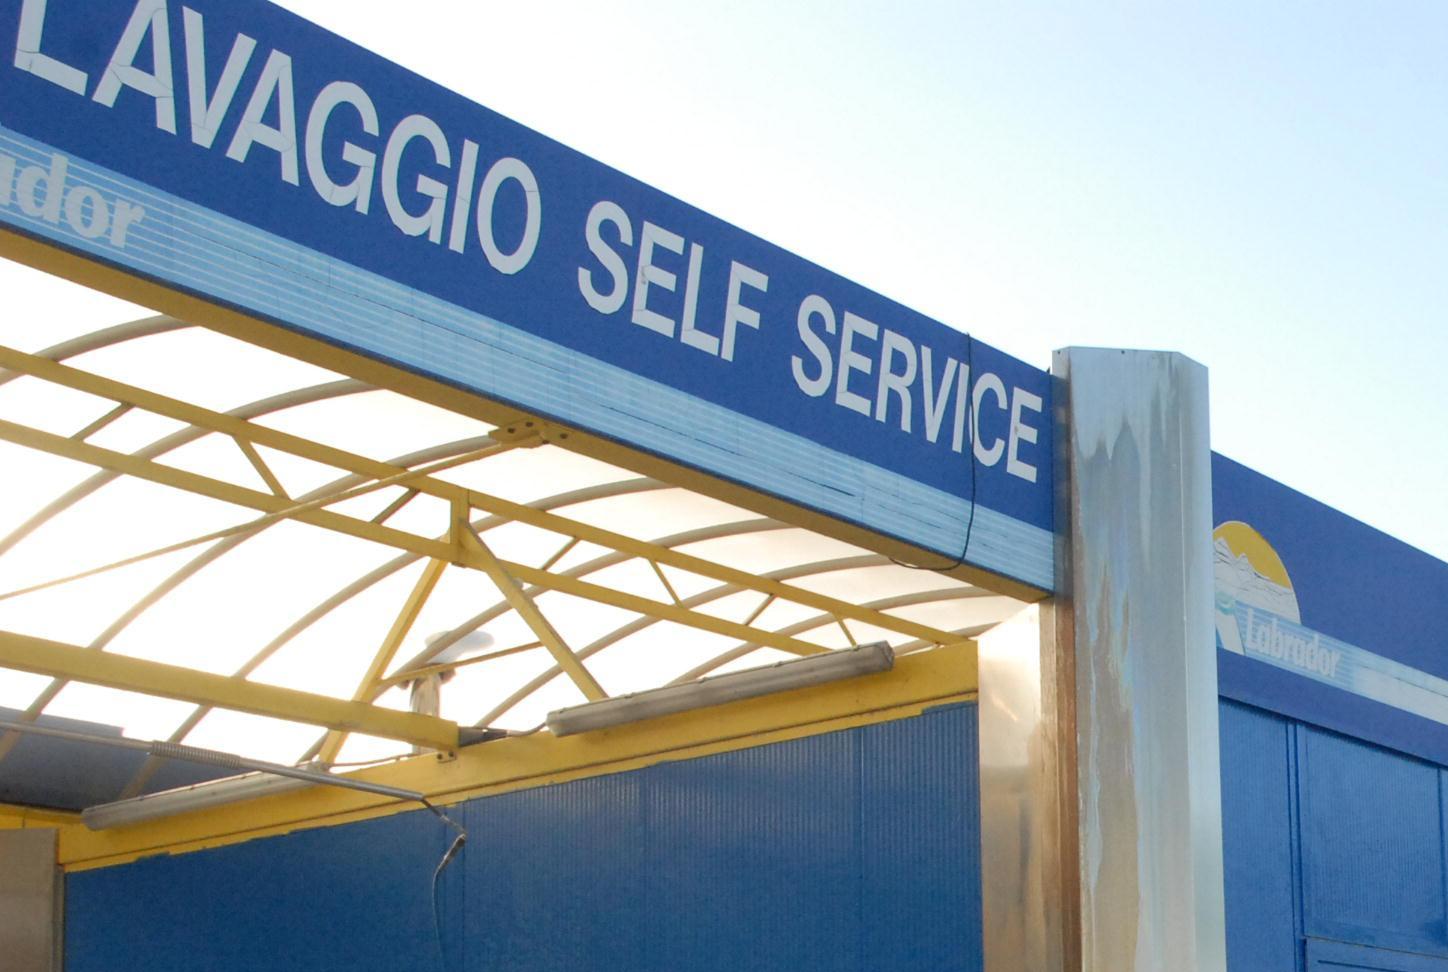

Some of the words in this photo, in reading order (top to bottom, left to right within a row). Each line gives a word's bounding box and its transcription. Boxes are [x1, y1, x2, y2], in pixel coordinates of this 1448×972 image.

[14, 0, 542, 275] LAVAGGIO
[578, 200, 769, 362] SELF
[791, 294, 1042, 483] SERVICE
[1245, 608, 1341, 678] Labrador
